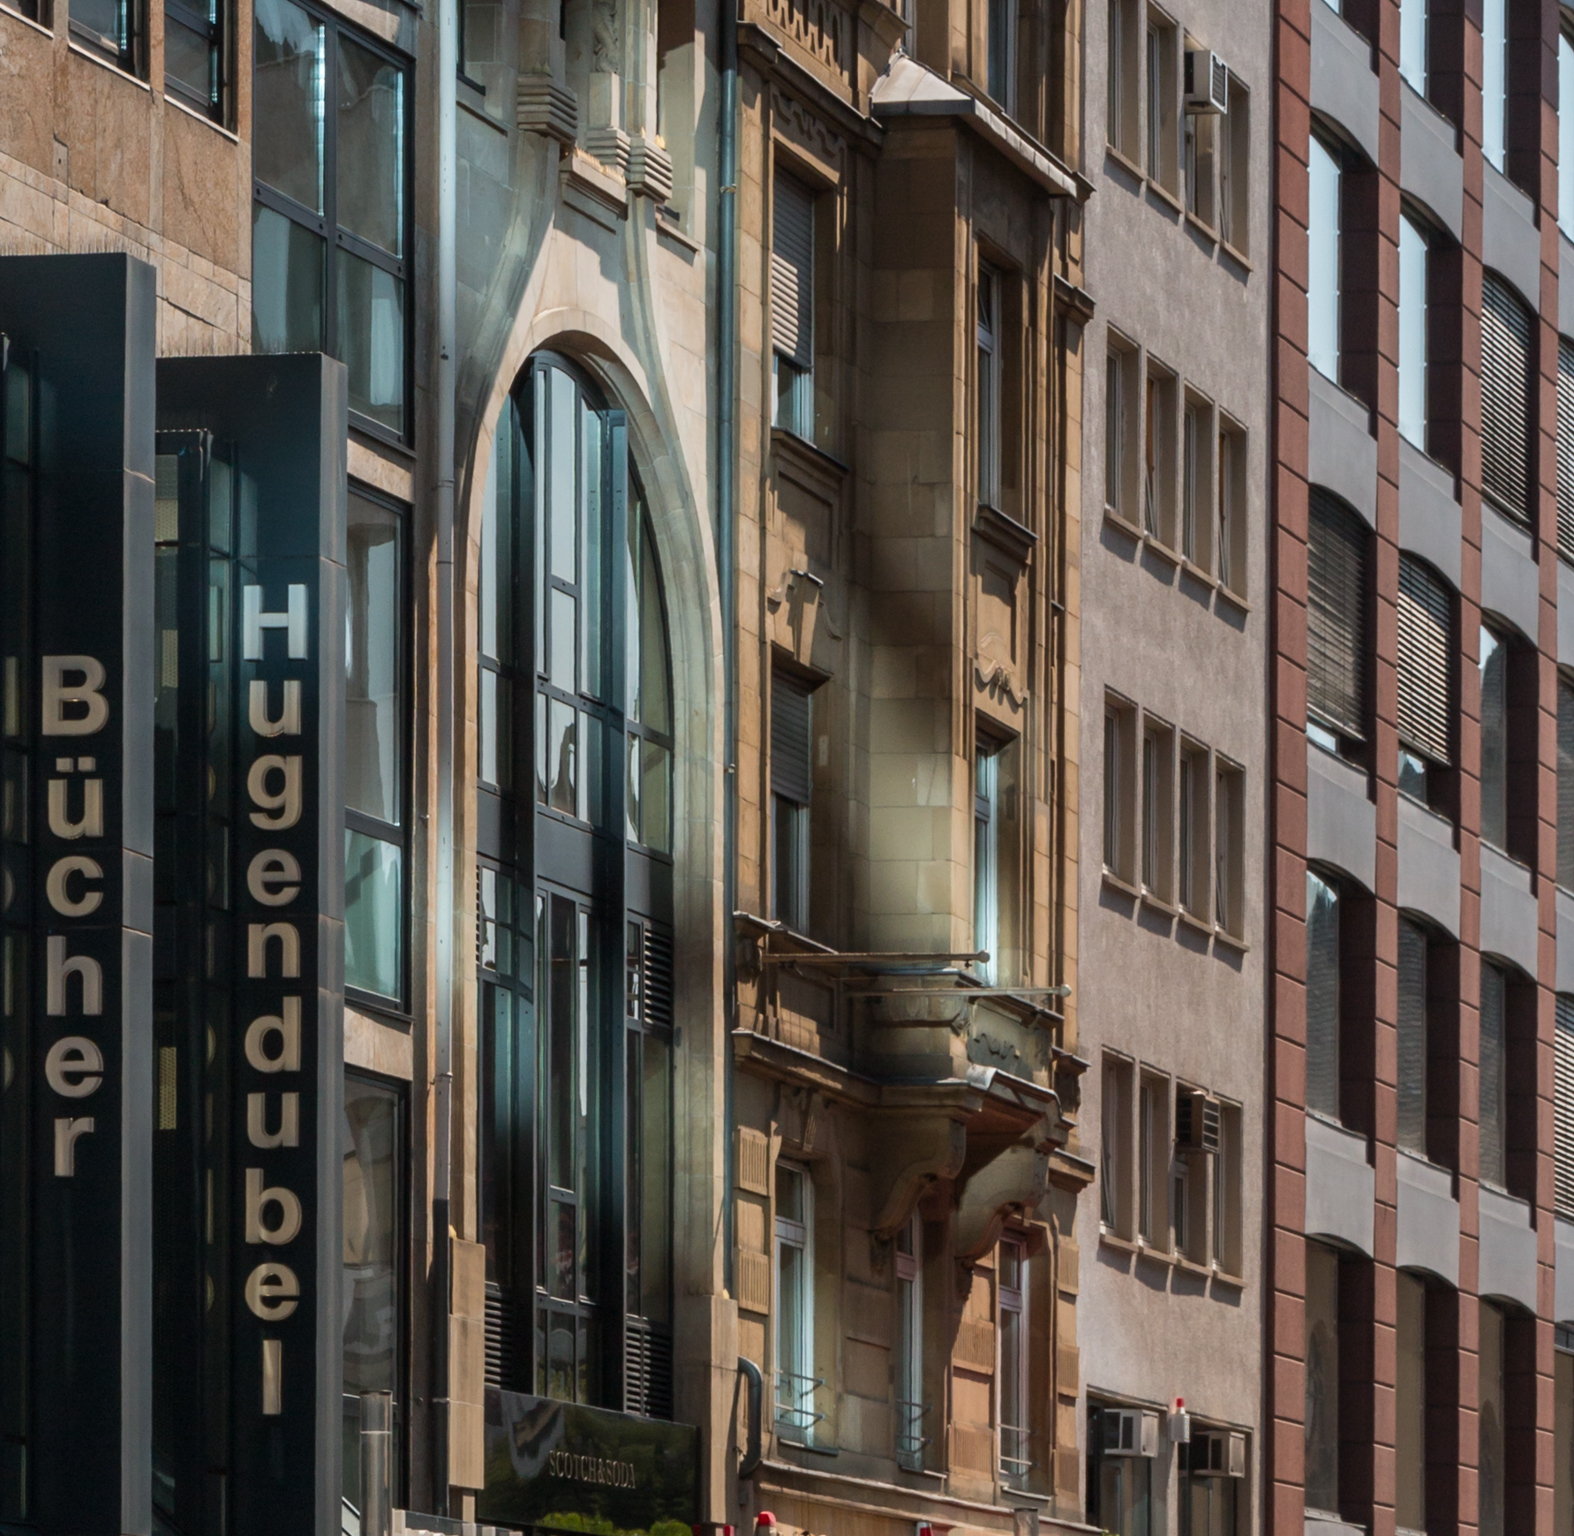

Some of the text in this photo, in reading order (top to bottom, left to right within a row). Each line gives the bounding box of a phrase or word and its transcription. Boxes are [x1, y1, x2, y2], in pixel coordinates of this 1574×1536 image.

[41, 654, 110, 1178] Bücher
[242, 583, 309, 1416] Hugendubel
[549, 1450, 636, 1489] SCOTCH&SODA
